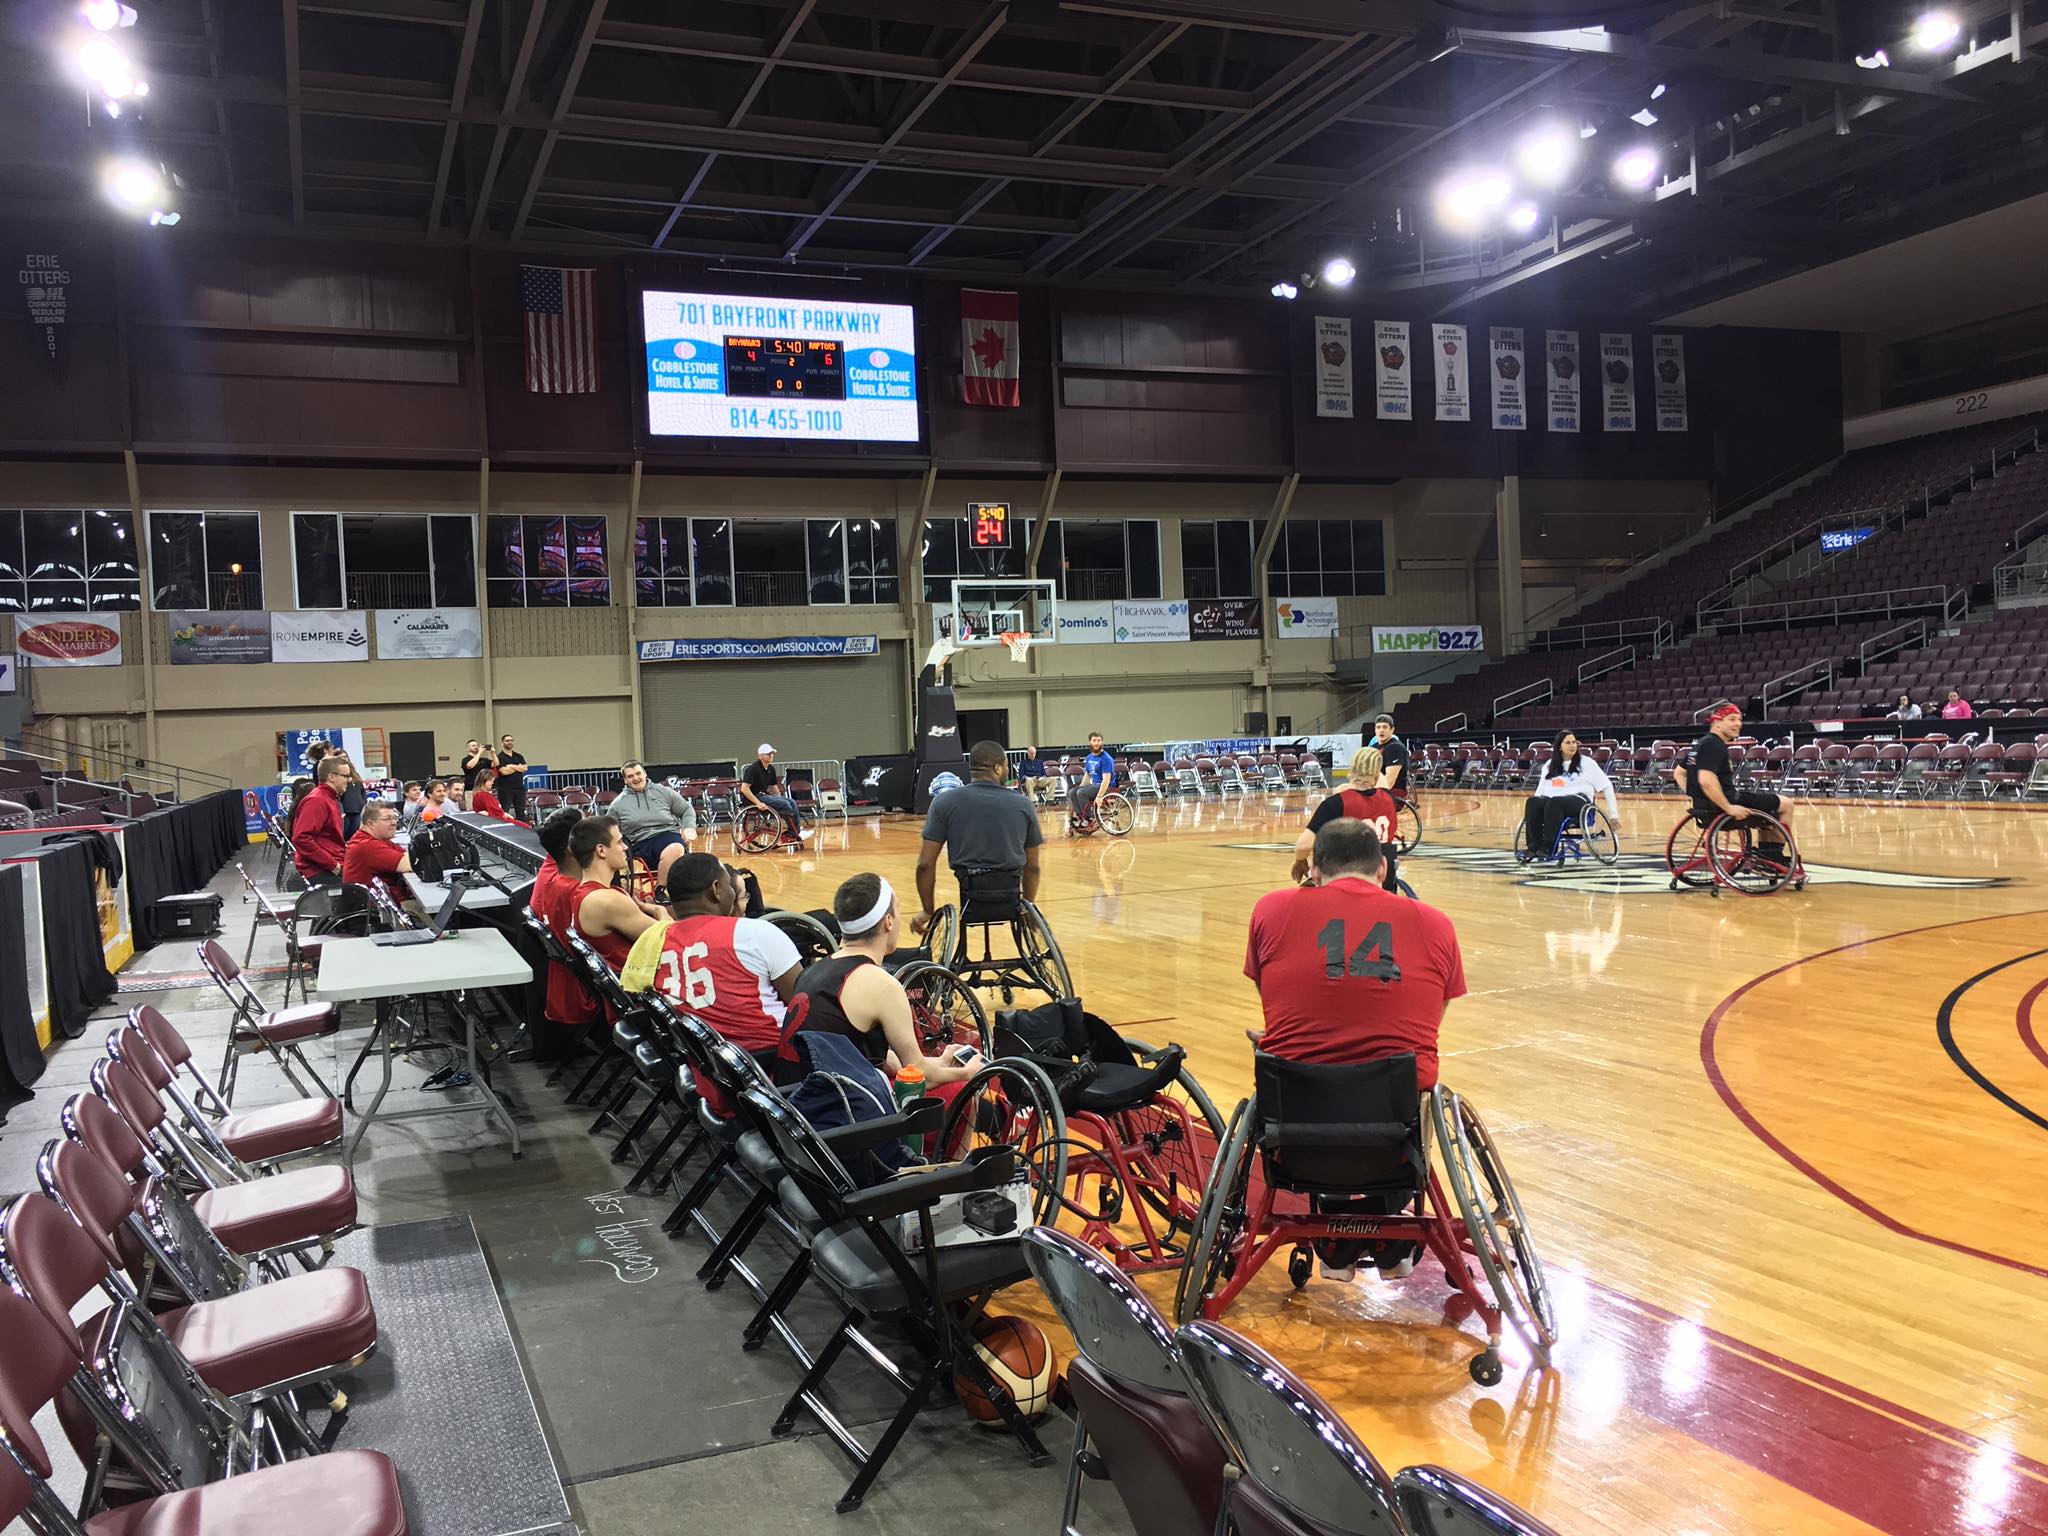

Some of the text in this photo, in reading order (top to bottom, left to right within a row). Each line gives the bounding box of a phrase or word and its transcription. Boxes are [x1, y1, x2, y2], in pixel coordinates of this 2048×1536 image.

[26, 254, 60, 268] ERIE
[19, 270, 71, 284] OTTERS
[679, 303, 881, 333] 701 BAYFRONT PARKWAY
[1378, 333, 1406, 341] OTTERS
[774, 340, 802, 353] 5:40
[808, 341, 836, 351] RAPTORS
[1494, 341, 1522, 351] OTTERS
[747, 350, 833, 366] 4 6
[788, 357, 795, 367] 2
[652, 358, 719, 375] COBBLESTONE
[850, 366, 911, 383] COBBLESTONE
[655, 374, 682, 390] HOTEL
[692, 375, 718, 391] SUITES
[776, 379, 802, 391] 0 0
[852, 383, 876, 397] HOTEL
[885, 383, 910, 398] SUITES
[1956, 393, 1989, 414] 222
[730, 407, 842, 431] 814-455-1010
[979, 507, 1005, 520] 5:40
[976, 520, 1002, 544] 24
[1224, 601, 1244, 609] OVER
[1059, 617, 1108, 628] Domino's
[27, 629, 111, 643] SANDER'S
[59, 642, 111, 650] MARKETS
[1317, 918, 1401, 983] 14
[656, 942, 716, 1010] 36
[584, 1190, 632, 1214] WEST
